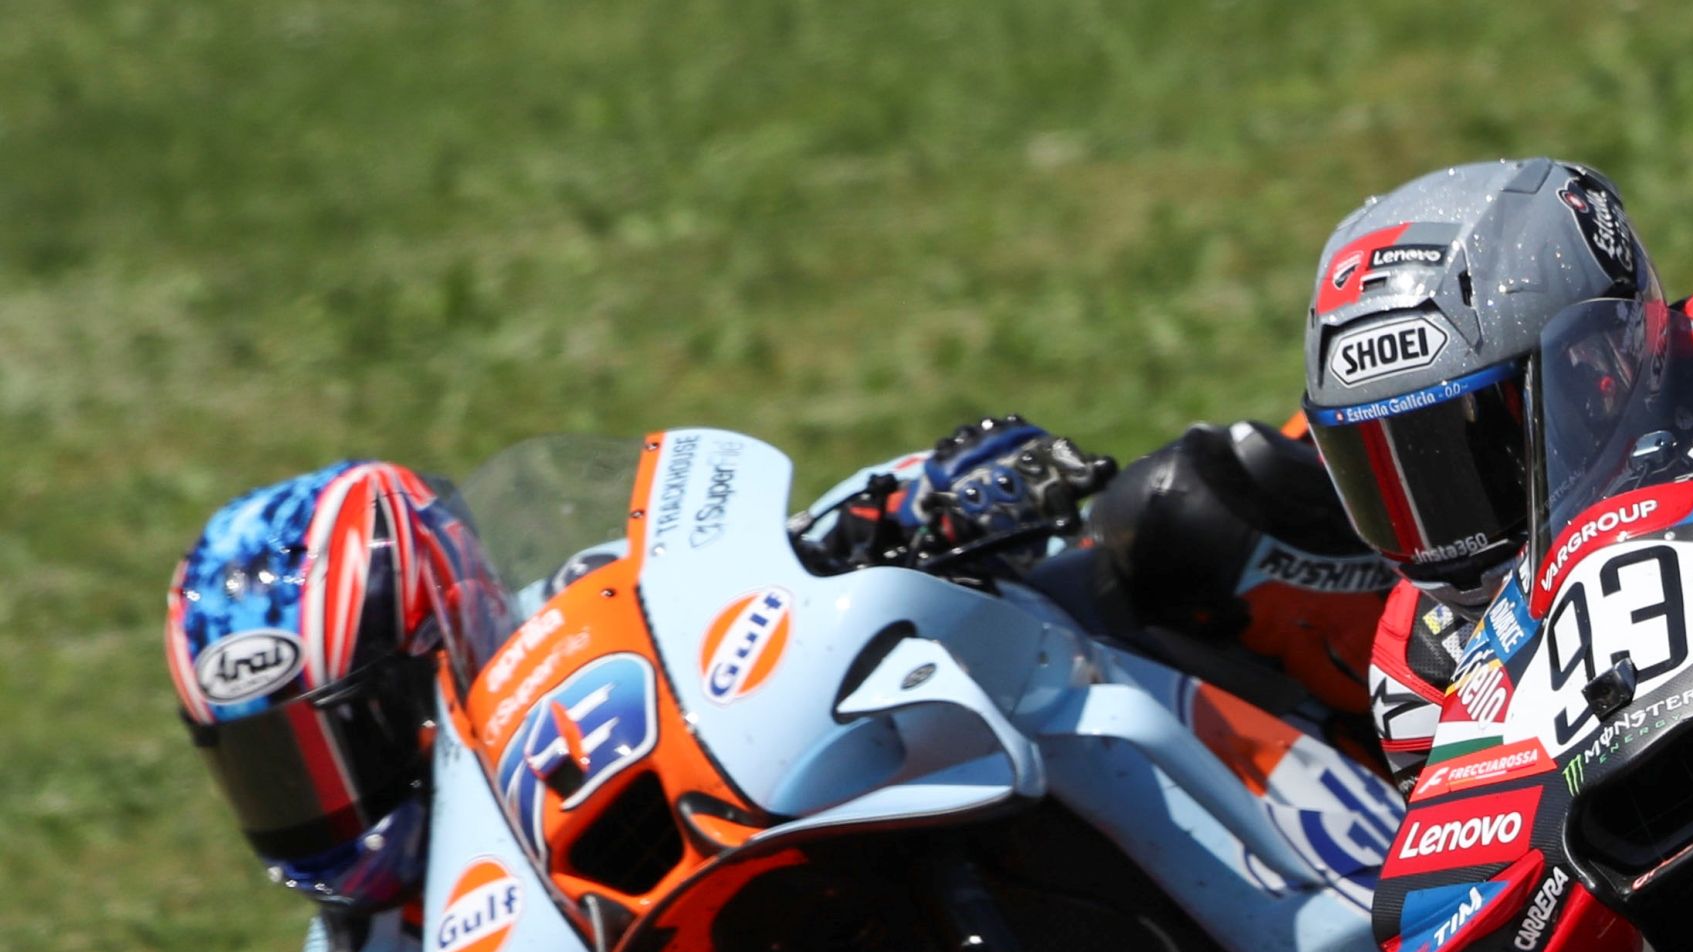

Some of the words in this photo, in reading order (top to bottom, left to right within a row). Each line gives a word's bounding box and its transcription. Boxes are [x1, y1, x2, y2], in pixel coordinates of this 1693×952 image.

[1373, 249, 1441, 266] Lenovo
[1341, 327, 1429, 376] SHOEI
[1346, 403, 1389, 423] Estrella
[1389, 390, 1436, 414] Galicia
[656, 434, 701, 537] TRACKHOUSE
[1415, 532, 1488, 564] Insta360
[1540, 499, 1658, 592] VARGROUP
[213, 641, 284, 682] Arai
[710, 588, 785, 697] Gulf
[1548, 544, 1689, 746] 93
[1447, 748, 1539, 782] FRECCIAROSSA
[1400, 810, 1522, 861] Lenovo
[437, 884, 521, 950] Gulf
[1433, 887, 1483, 949] TIM
[1513, 866, 1569, 952] CARRERA
